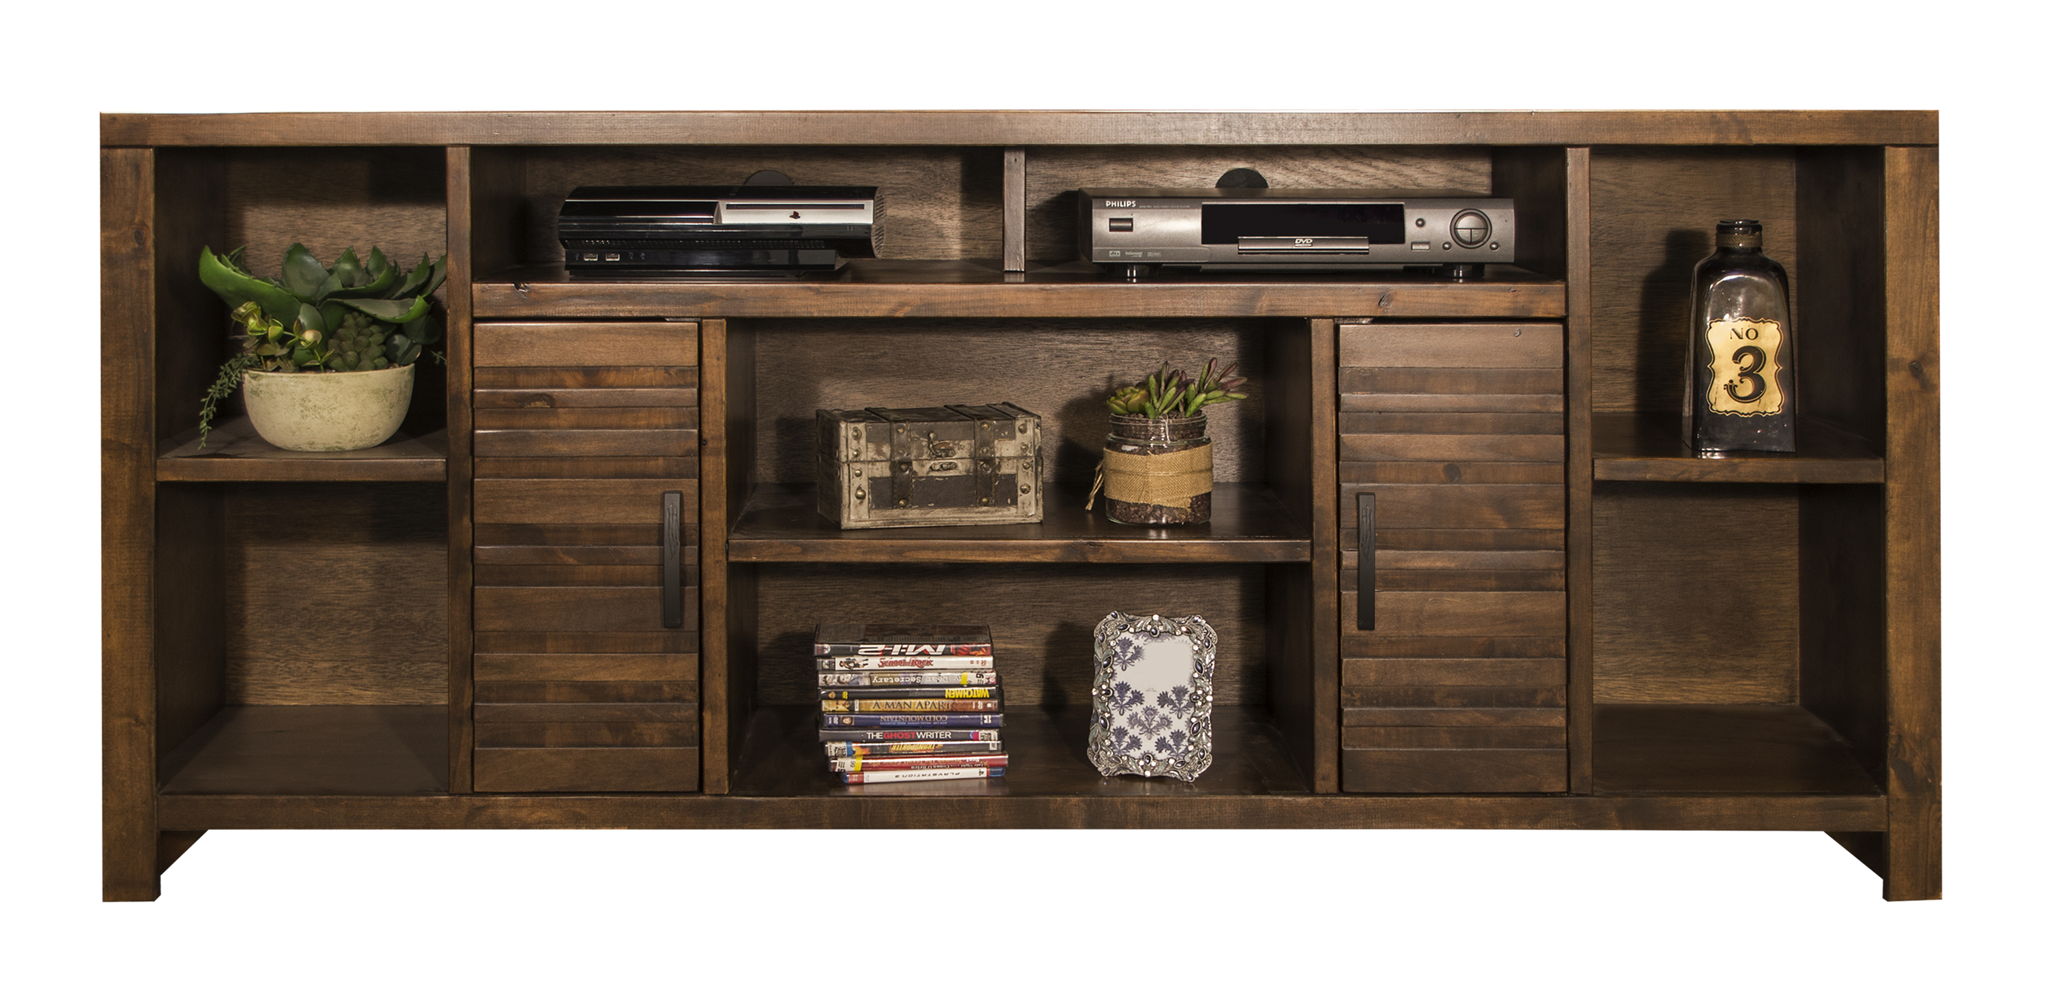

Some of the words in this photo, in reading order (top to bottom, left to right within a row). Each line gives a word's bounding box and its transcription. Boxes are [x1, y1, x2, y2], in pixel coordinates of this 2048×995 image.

[1105, 200, 1136, 208] PHILIPS
[1730, 327, 1759, 341] NO
[1723, 345, 1767, 404] 3
[872, 674, 922, 684] Secretary
[945, 689, 989, 699] WATCHMEN
[872, 701, 881, 709] A
[885, 701, 912, 709] MAN
[916, 701, 953, 709] APART
[867, 732, 883, 740] THE
[916, 731, 952, 739] WRITER
